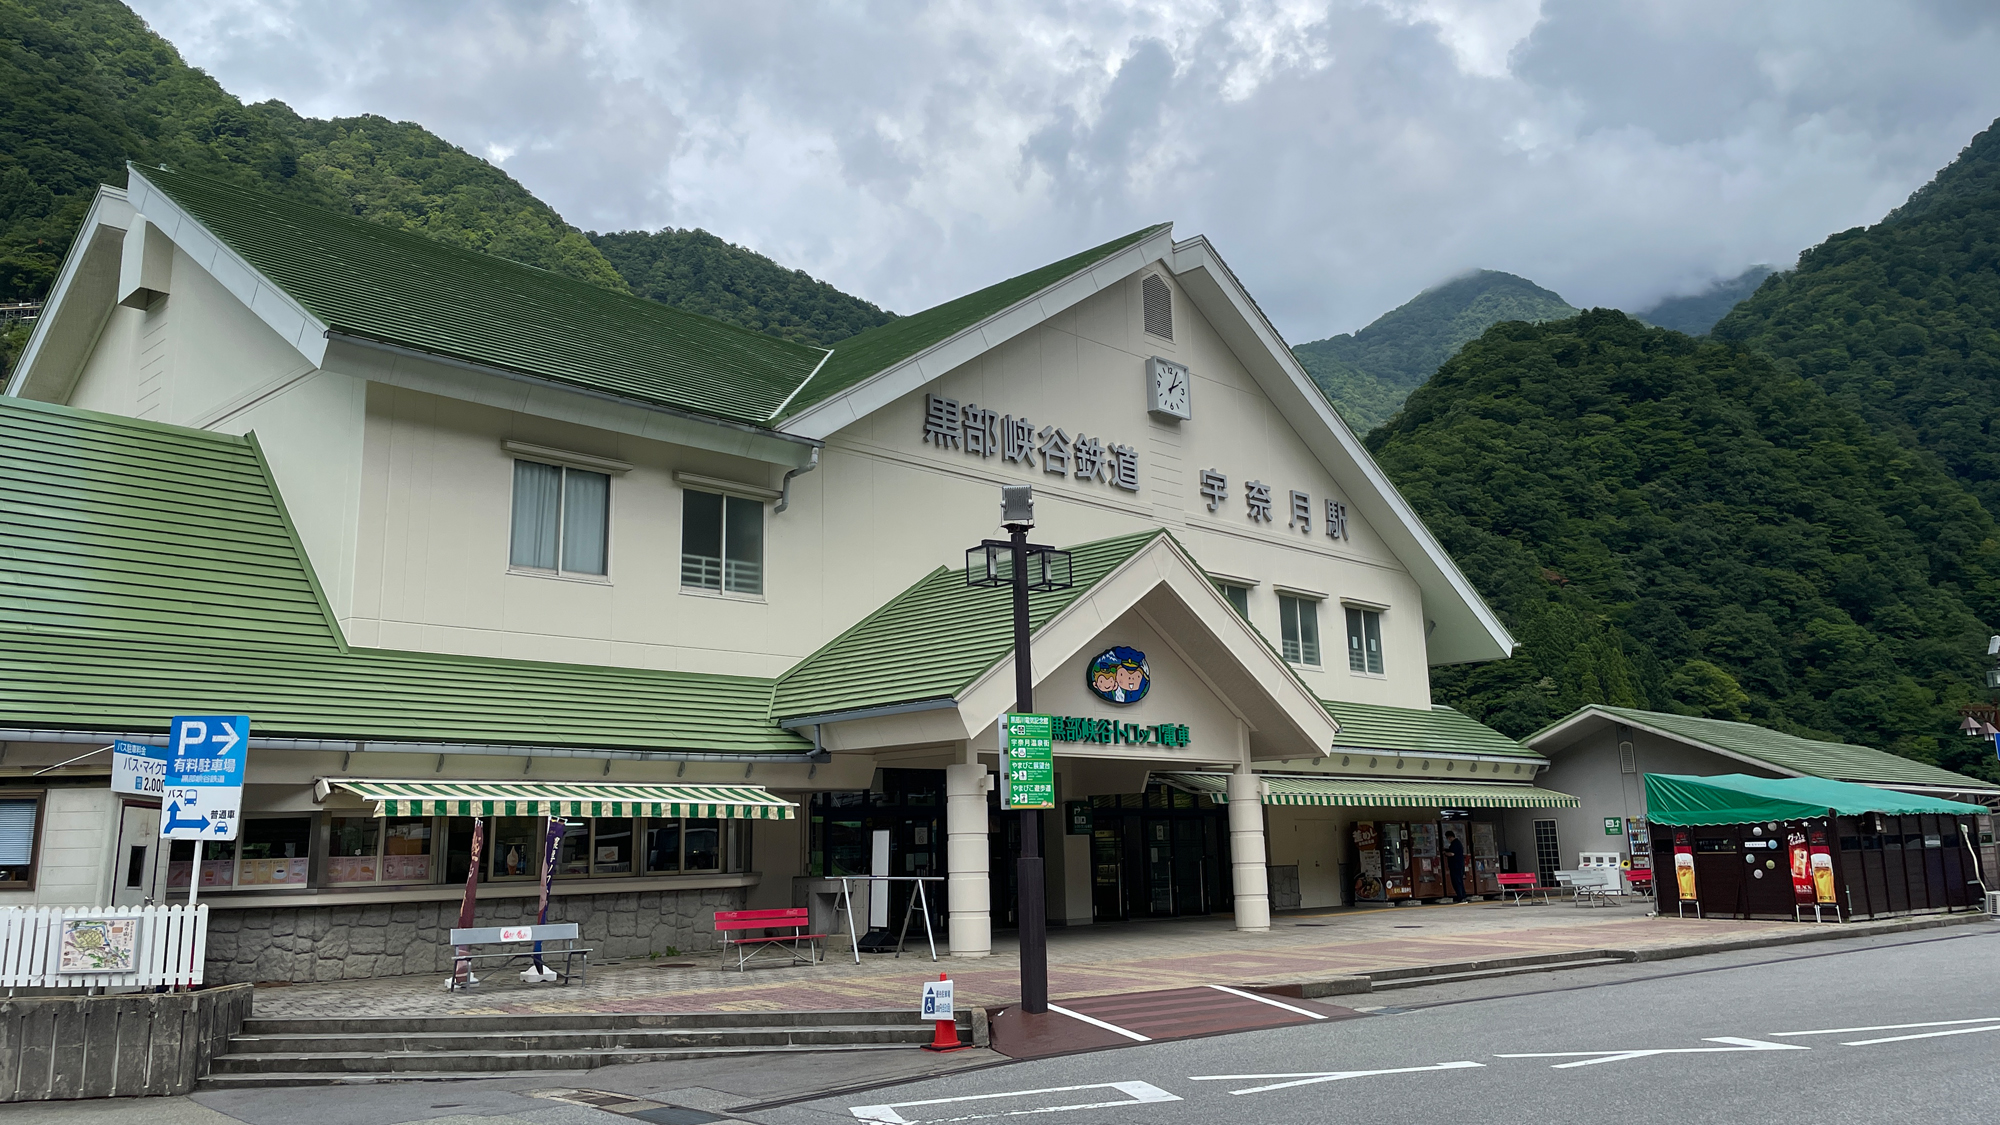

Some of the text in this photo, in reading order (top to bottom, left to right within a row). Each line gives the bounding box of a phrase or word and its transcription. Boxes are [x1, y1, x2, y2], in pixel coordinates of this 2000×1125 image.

[1167, 367, 1173, 375] 12
[923, 393, 1140, 492] 黒部峡谷鉄道
[1200, 467, 1350, 540] 宇奈月駅
[177, 721, 208, 756] P
[1051, 716, 1191, 747] 黒部峡谷トロッコ電車
[173, 758, 236, 773] 有料駐車場
[168, 789, 184, 798] バス
[210, 809, 235, 820] 普通車
